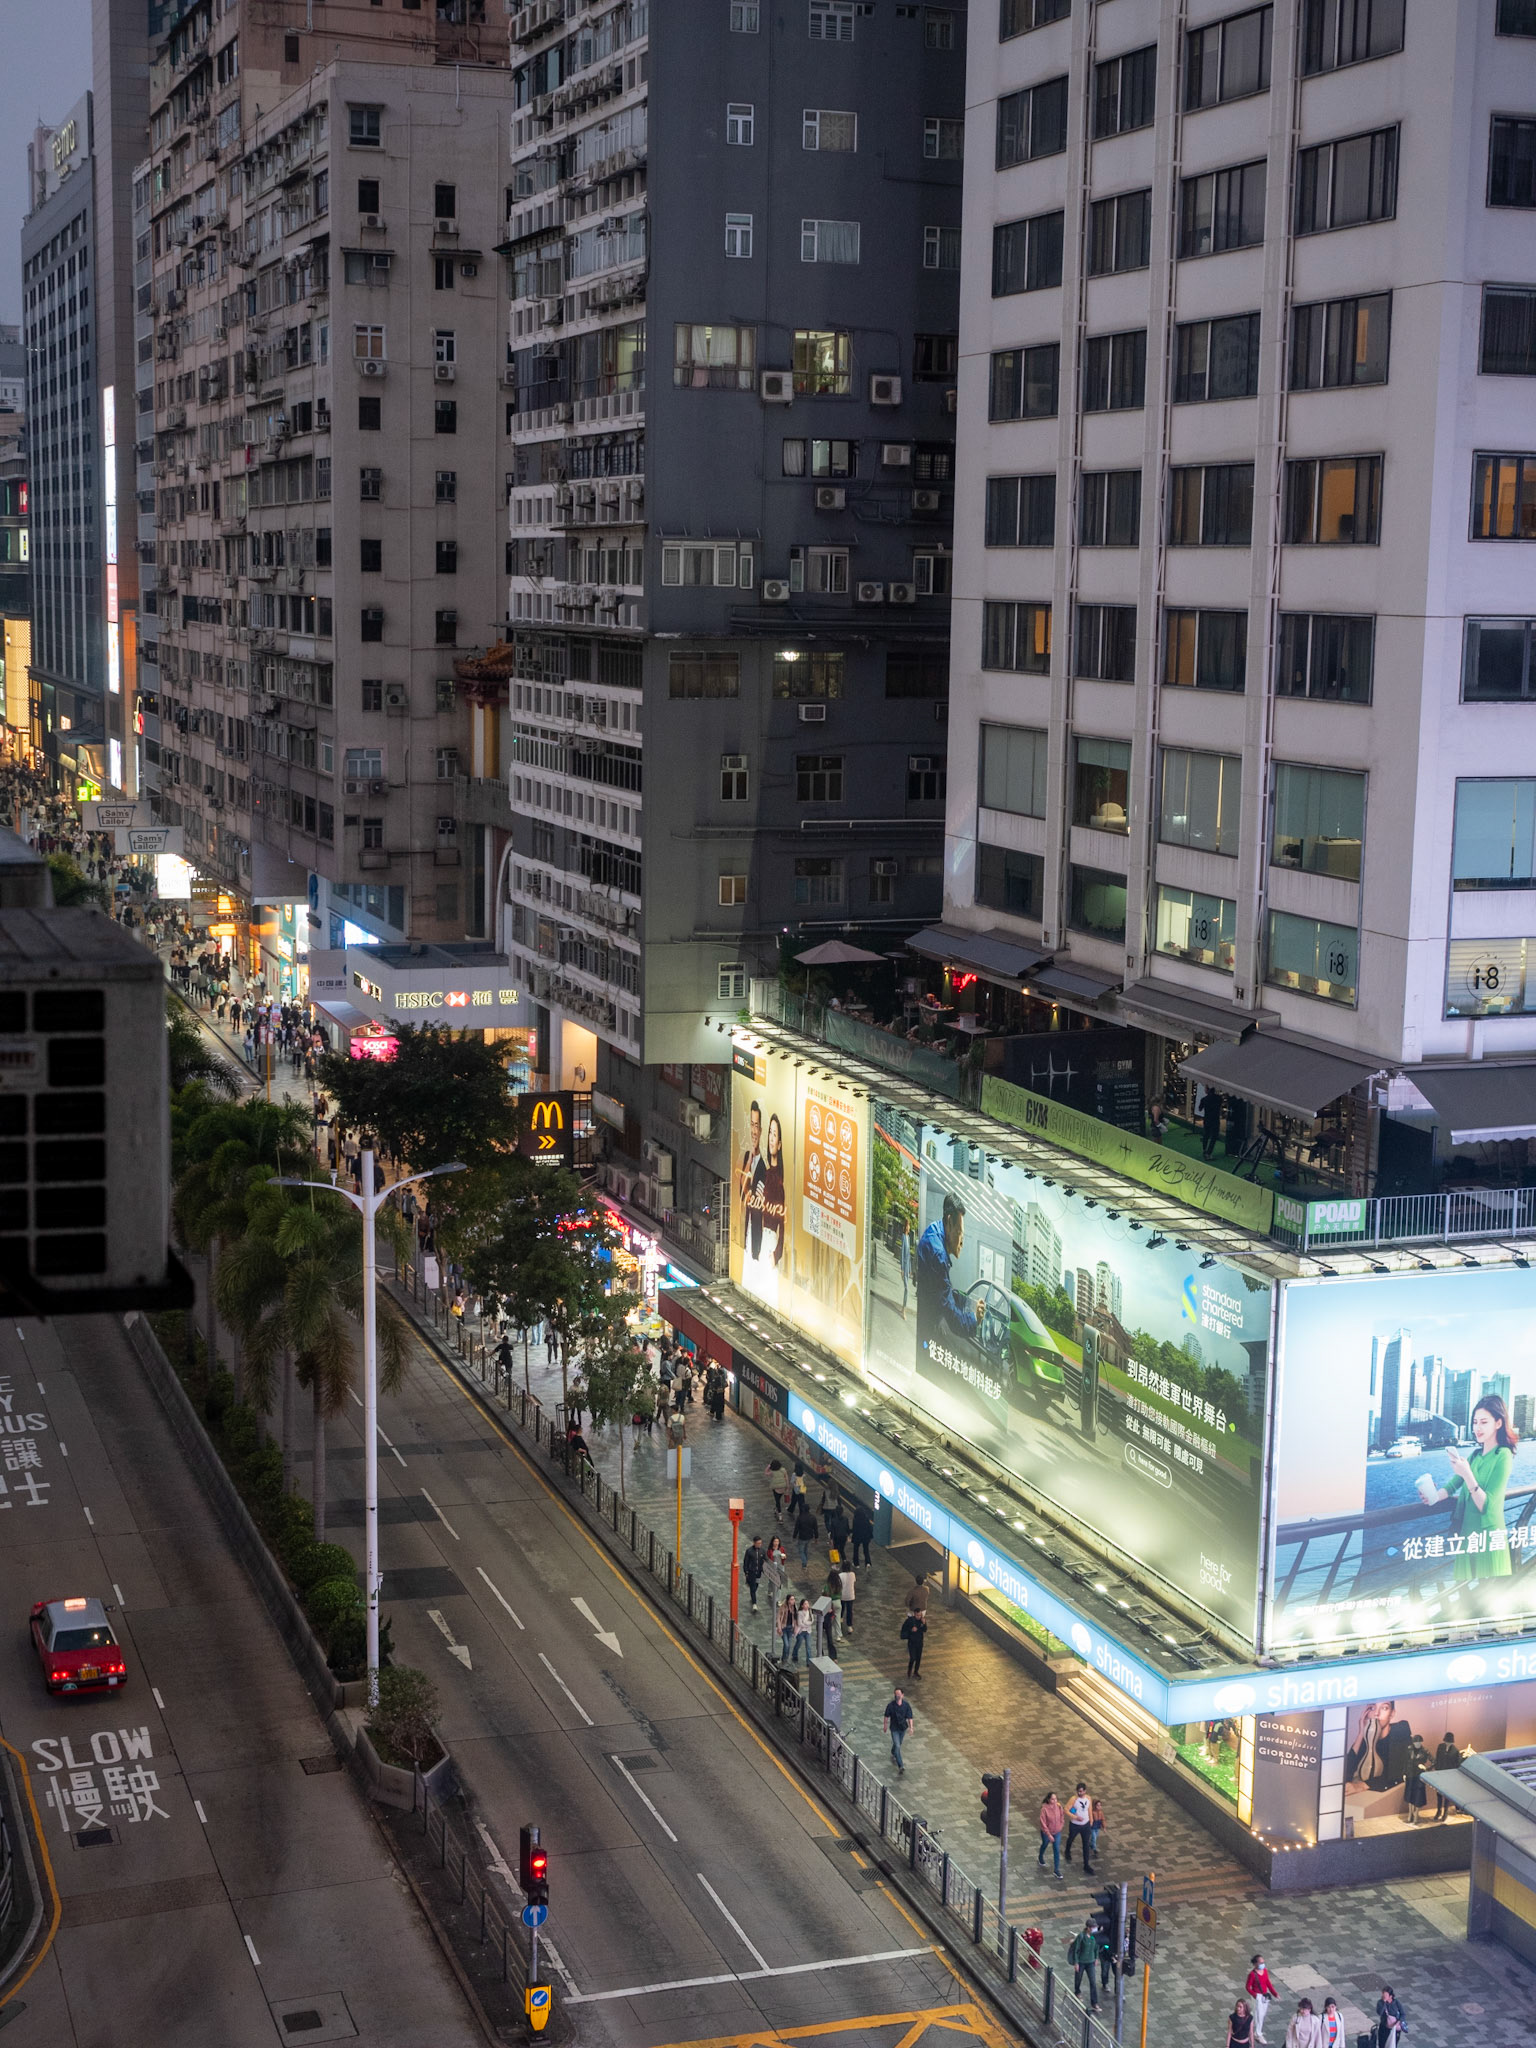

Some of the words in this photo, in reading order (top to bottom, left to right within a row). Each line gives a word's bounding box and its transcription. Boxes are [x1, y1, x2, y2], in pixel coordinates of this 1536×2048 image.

[101, 815, 126, 825] tailor
[105, 808, 129, 817] Sam's
[133, 840, 158, 850] tailor
[137, 834, 163, 842] Sam's
[395, 991, 444, 1009] HSBC
[1026, 1098, 1049, 1129] GYM
[1148, 1154, 1172, 1175] We
[1160, 1161, 1206, 1199] Build
[1277, 1197, 1304, 1225] POAD
[1314, 1201, 1361, 1223] POAD
[1201, 1299, 1244, 1329] chartered
[1202, 1284, 1242, 1314] standard
[1201, 1312, 1232, 1340] 渣打銀行
[929, 1339, 1002, 1400] 從支持本地創科起步
[764, 1381, 778, 1403] DBS
[1127, 1357, 1227, 1434] 到昂然進軍世界舞台
[818, 1423, 848, 1463] shama
[1125, 1413, 1141, 1436] 從此
[1142, 1424, 1172, 1456] 無限可能
[897, 1485, 932, 1531] shama
[1200, 1551, 1219, 1576] here
[1219, 1563, 1232, 1584] for
[988, 1558, 1028, 1608] shama
[1096, 1643, 1143, 1700] shama
[1267, 1674, 1358, 1707] shama
[1259, 1720, 1318, 1737] GIORDANO
[31, 1726, 154, 1772] SLOW
[1258, 1747, 1317, 1764] GIORDANO
[1280, 1758, 1308, 1768] junior
[45, 1764, 171, 1832] 慢駛
